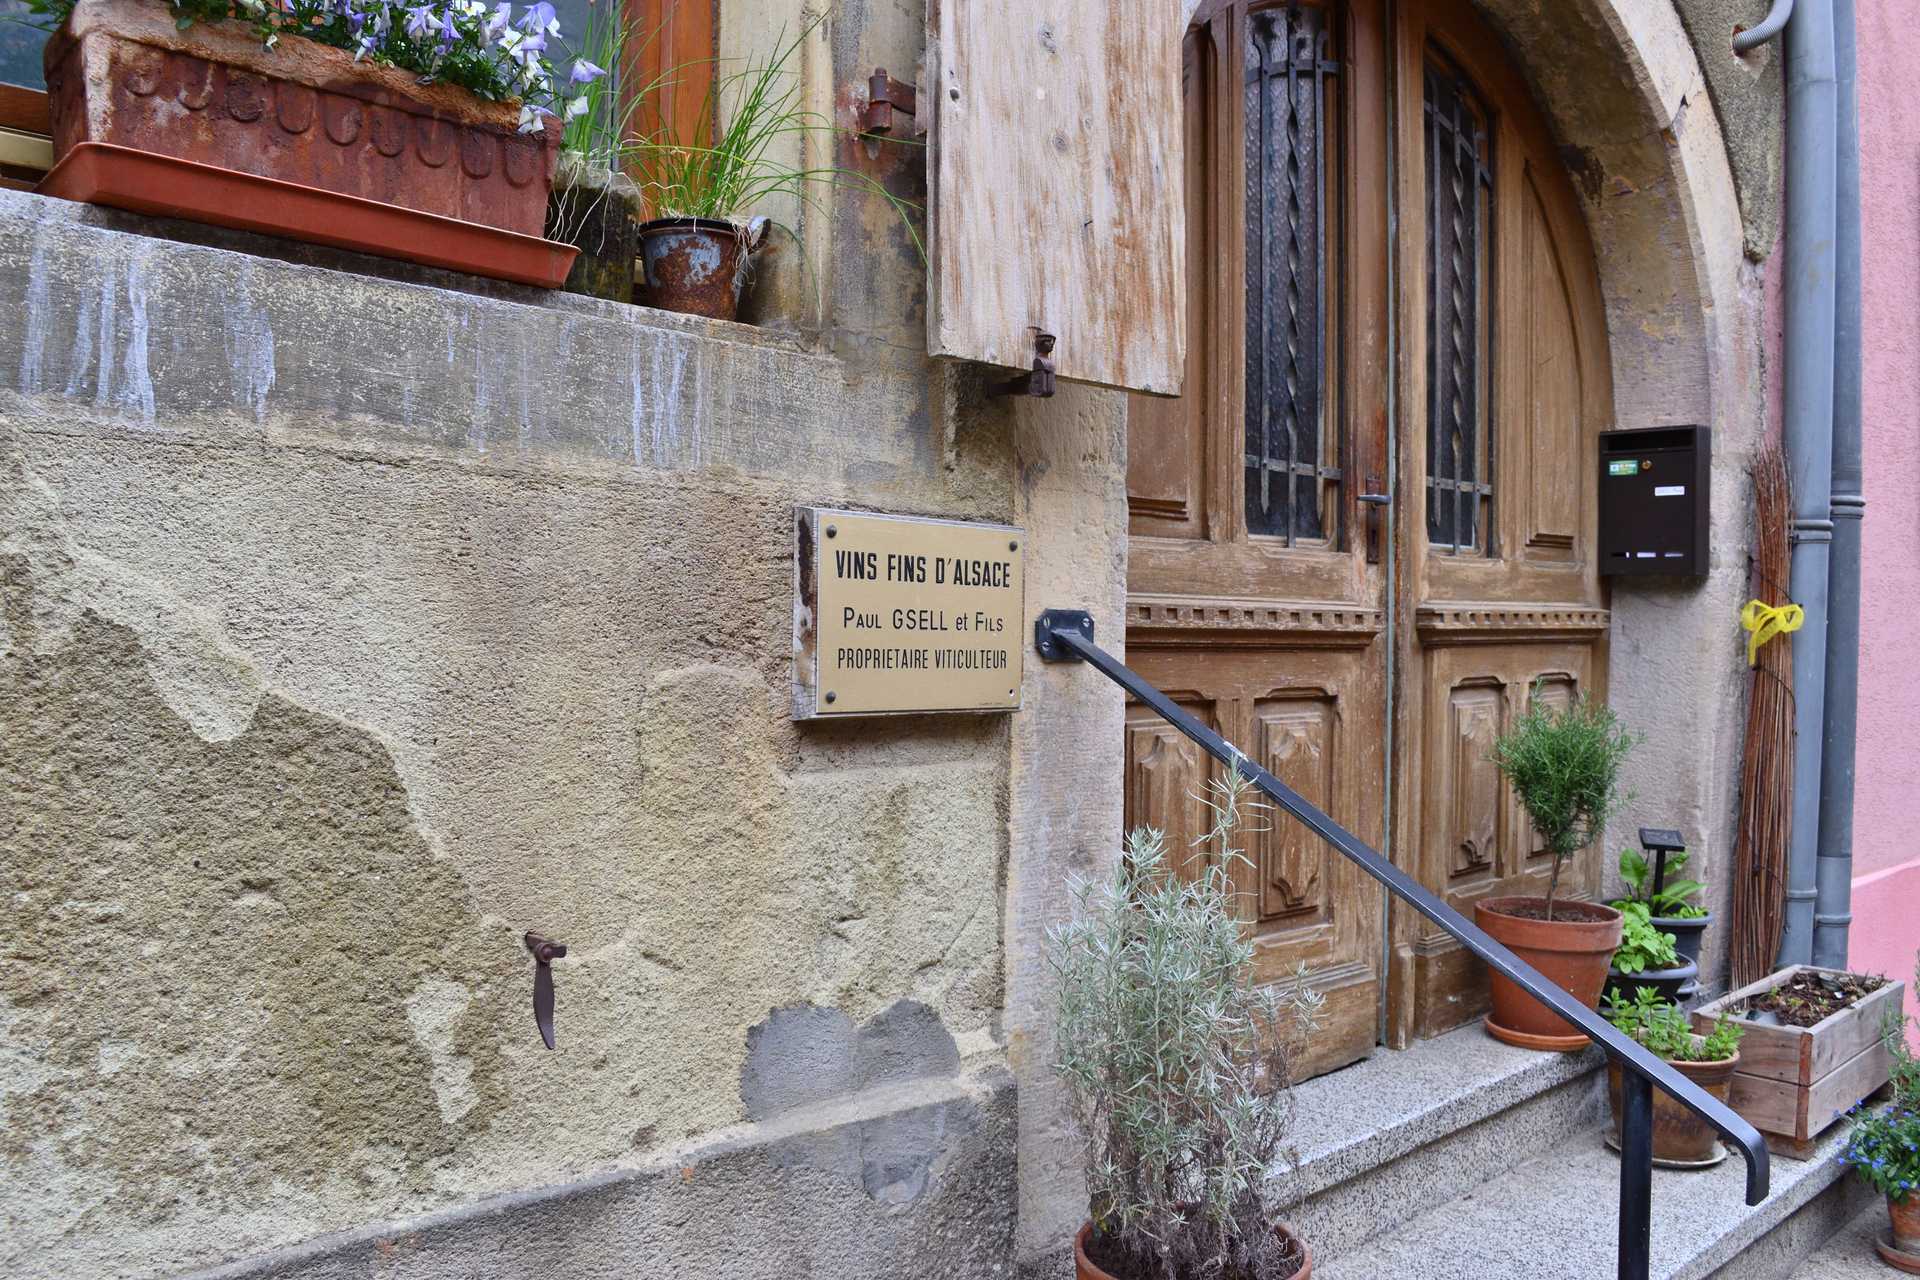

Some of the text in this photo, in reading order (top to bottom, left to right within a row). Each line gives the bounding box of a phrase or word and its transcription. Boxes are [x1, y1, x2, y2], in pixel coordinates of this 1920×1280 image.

[836, 550, 1010, 588] VINS FINS D'ALSACE
[893, 609, 948, 631] GSELL
[956, 612, 968, 631] et
[838, 648, 1007, 669] PROPRIETAIRE VITICULTEUR
